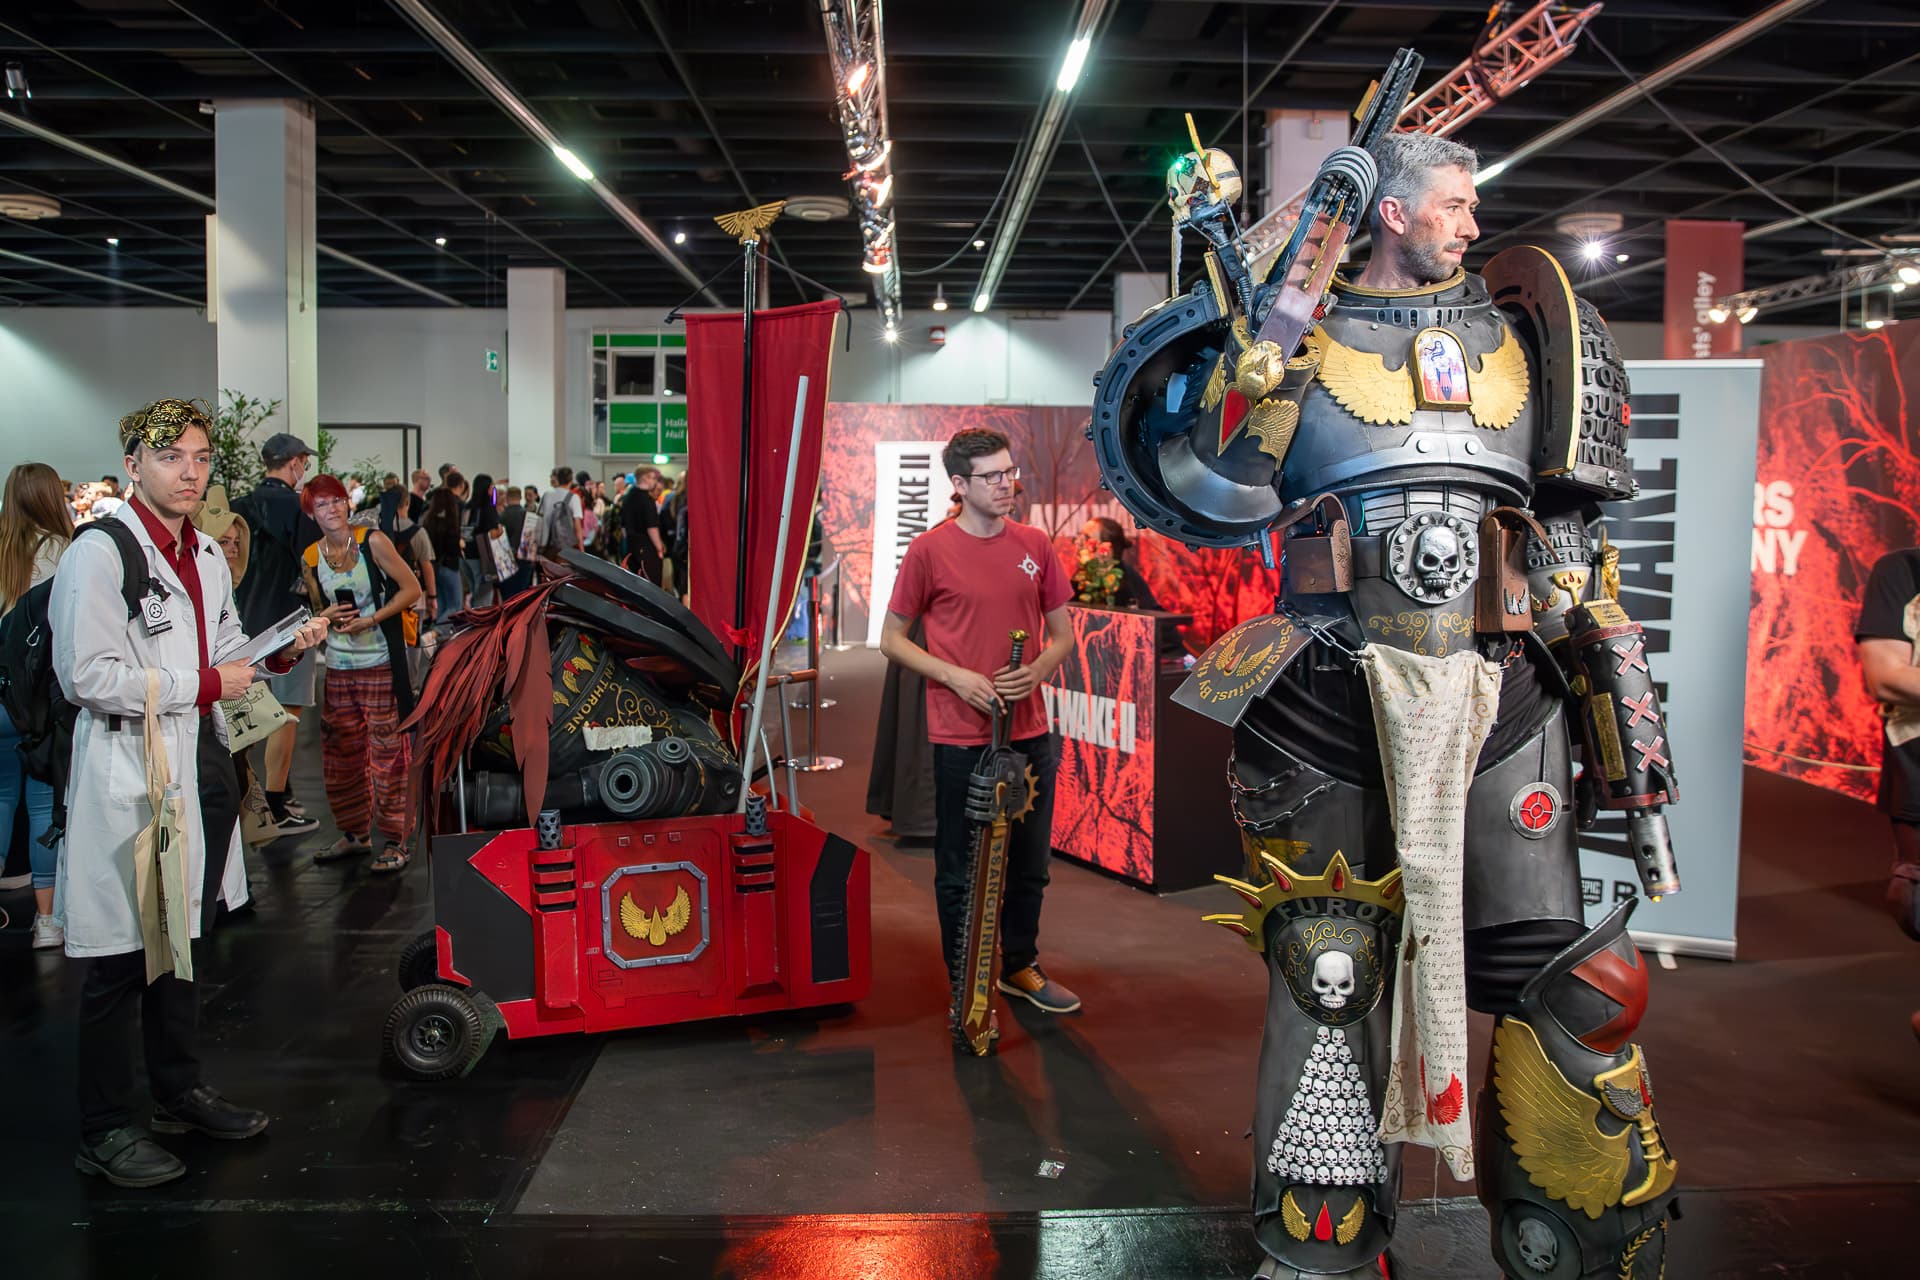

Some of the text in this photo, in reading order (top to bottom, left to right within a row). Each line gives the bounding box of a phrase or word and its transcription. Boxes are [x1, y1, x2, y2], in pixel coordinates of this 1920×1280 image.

[899, 454, 931, 470] II
[1751, 527, 1808, 576] NY
[567, 679, 609, 734] THRONE
[1057, 688, 1118, 750] WAKE
[1120, 701, 1137, 754] II
[977, 853, 1002, 982] SANGUINIUS
